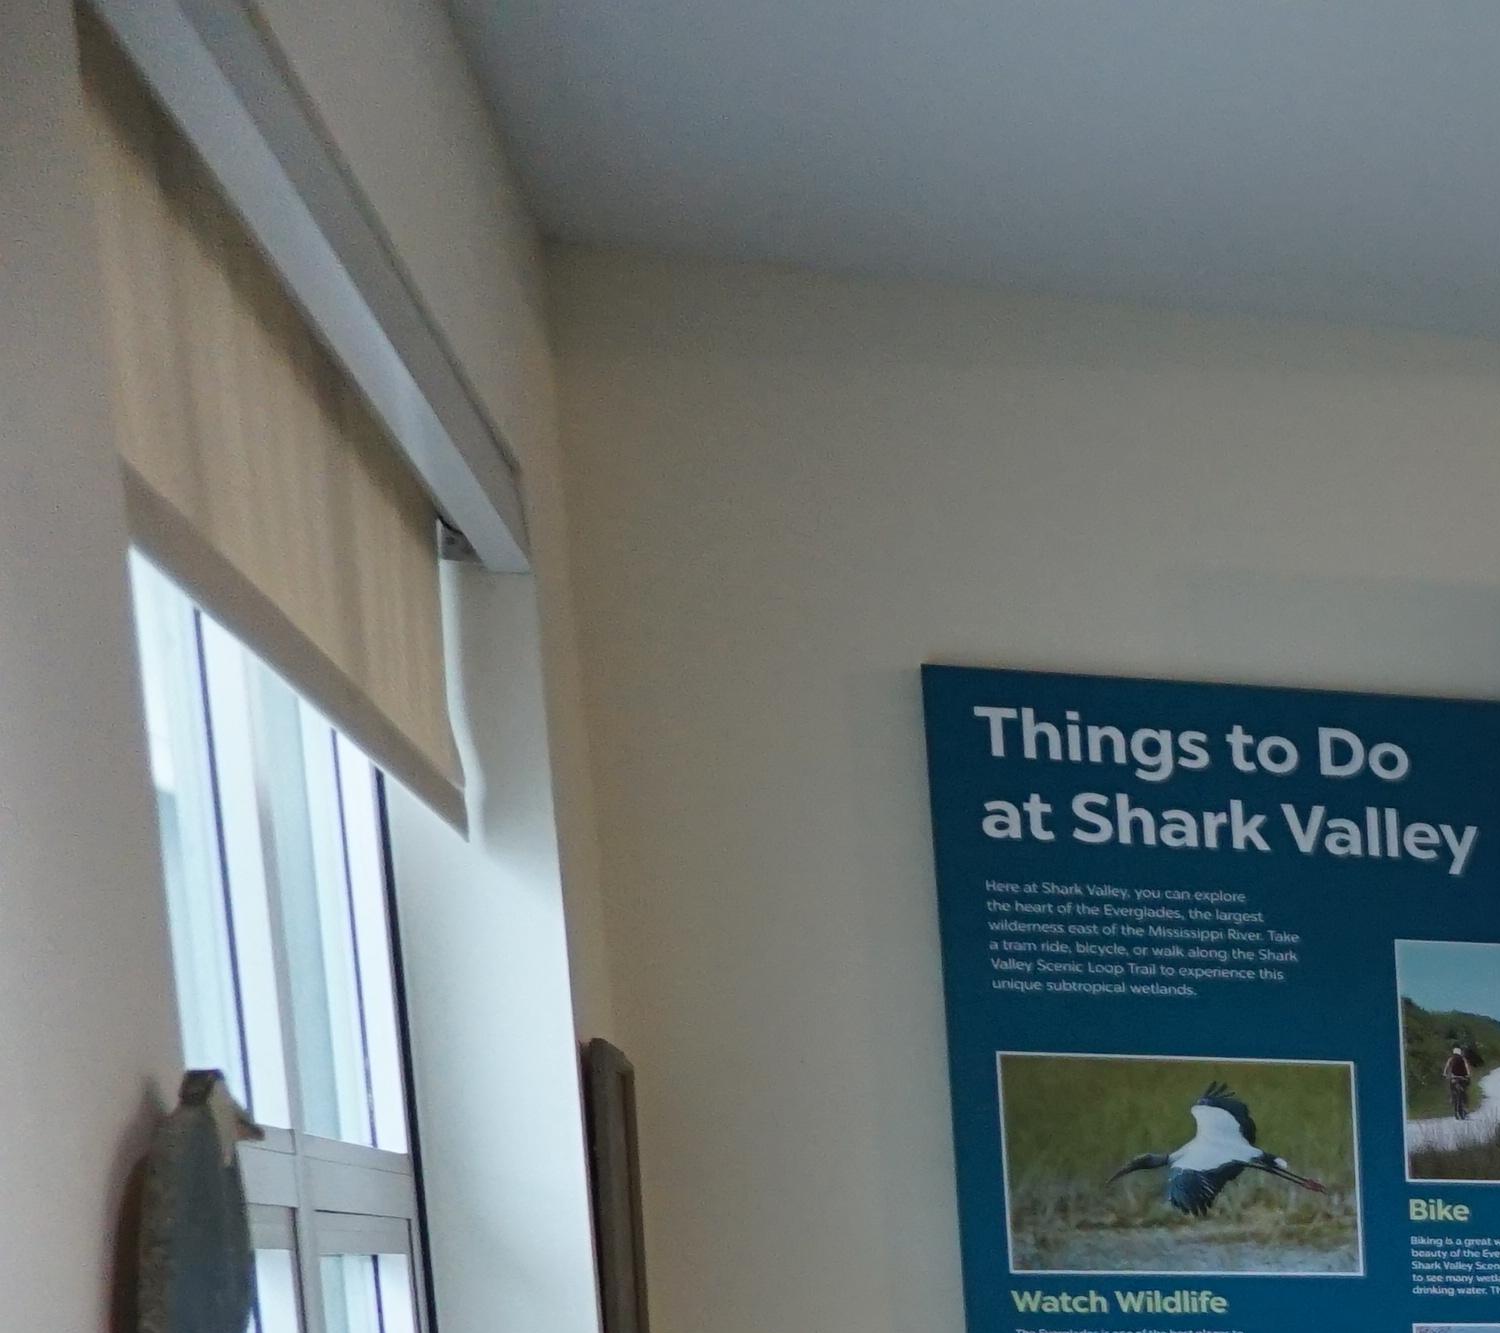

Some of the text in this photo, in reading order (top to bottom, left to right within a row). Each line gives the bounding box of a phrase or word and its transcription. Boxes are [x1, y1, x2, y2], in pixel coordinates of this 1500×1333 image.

[973, 705, 1410, 781] Things to Do
[981, 791, 1479, 876] at Shark Valley
[986, 880, 1020, 893] Here
[1024, 882, 1038, 893] at
[1042, 883, 1083, 895] Shark
[1135, 889, 1160, 901] you
[1165, 890, 1191, 899] can
[987, 900, 1011, 912] the
[1015, 902, 1053, 914] heart
[1057, 903, 1072, 915] of
[1077, 904, 1100, 916] the
[1189, 908, 1212, 920] the
[1069, 922, 1099, 934] east
[1103, 924, 1116, 935] of
[1122, 924, 1145, 936] the
[1267, 930, 1300, 942] Take
[990, 942, 999, 950] a
[1003, 939, 1037, 952] tram
[1133, 946, 1148, 955] or
[1152, 945, 1184, 957] walk
[1188, 946, 1227, 961] along
[1232, 947, 1255, 959] the
[1259, 948, 1298, 961] Shark
[1088, 962, 1124, 977] Loop
[1128, 963, 1156, 975] Trail
[1160, 964, 1175, 976] to
[1259, 968, 1284, 980] this
[1408, 1198, 1470, 1221] Bike
[1011, 1290, 1229, 1314] Watch Wildlife
